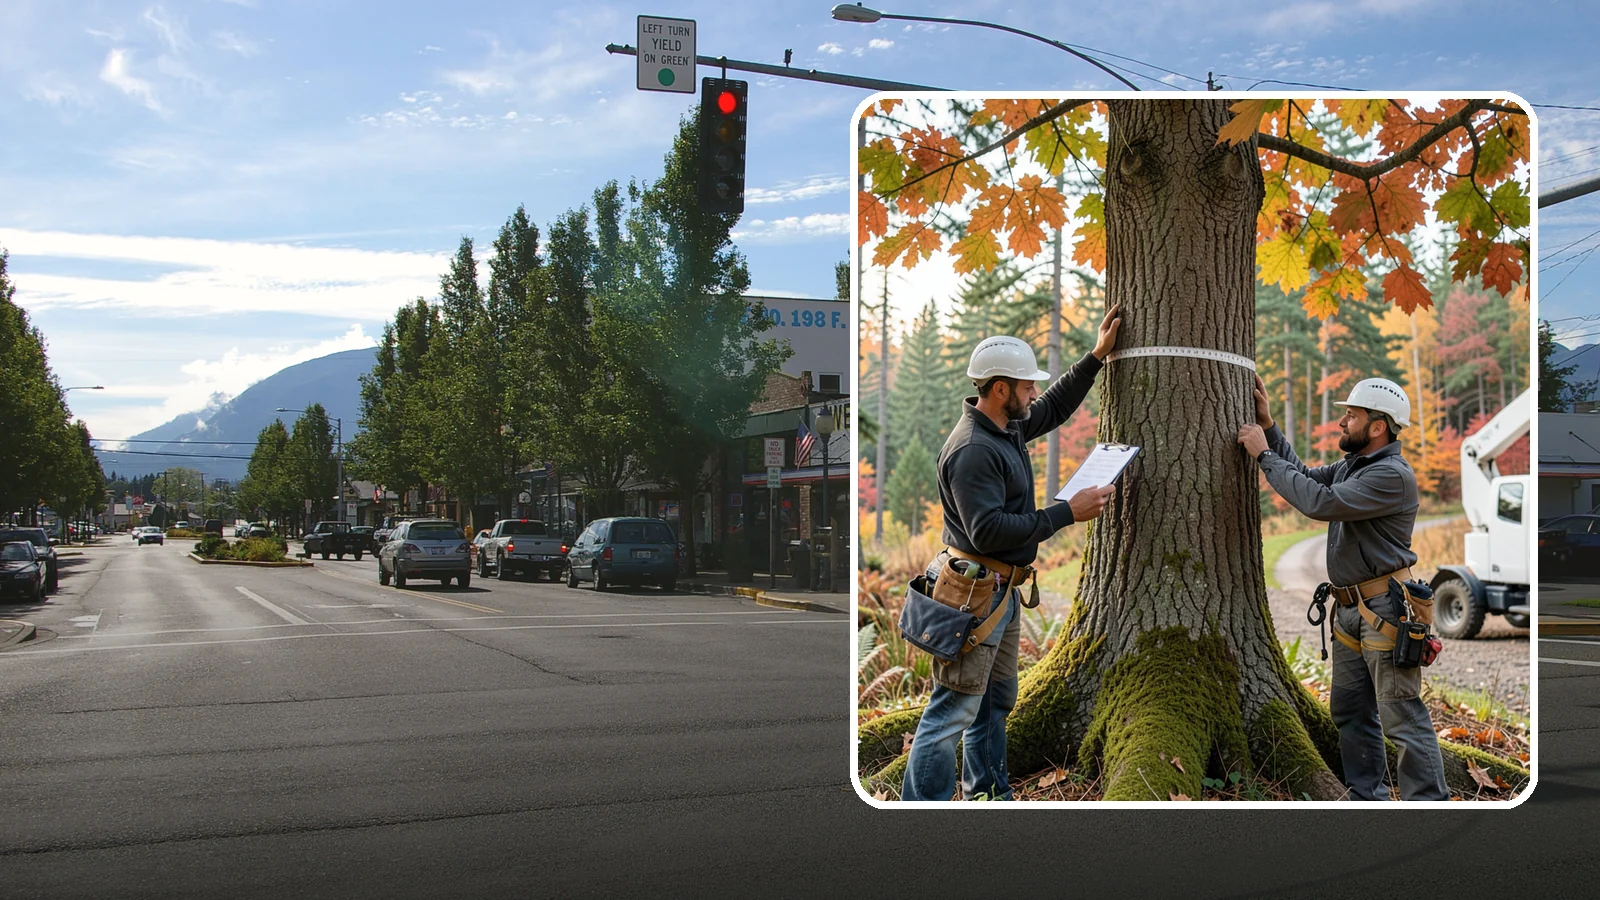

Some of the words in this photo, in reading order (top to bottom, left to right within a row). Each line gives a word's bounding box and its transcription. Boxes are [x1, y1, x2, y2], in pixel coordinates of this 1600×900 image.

[643, 23, 663, 34] LEFT
[668, 25, 690, 37] TURN
[652, 38, 682, 52] YIELD
[644, 53, 656, 63] ON
[661, 55, 689, 66] GREEN
[791, 309, 826, 328] 198
[831, 311, 847, 329] F.
